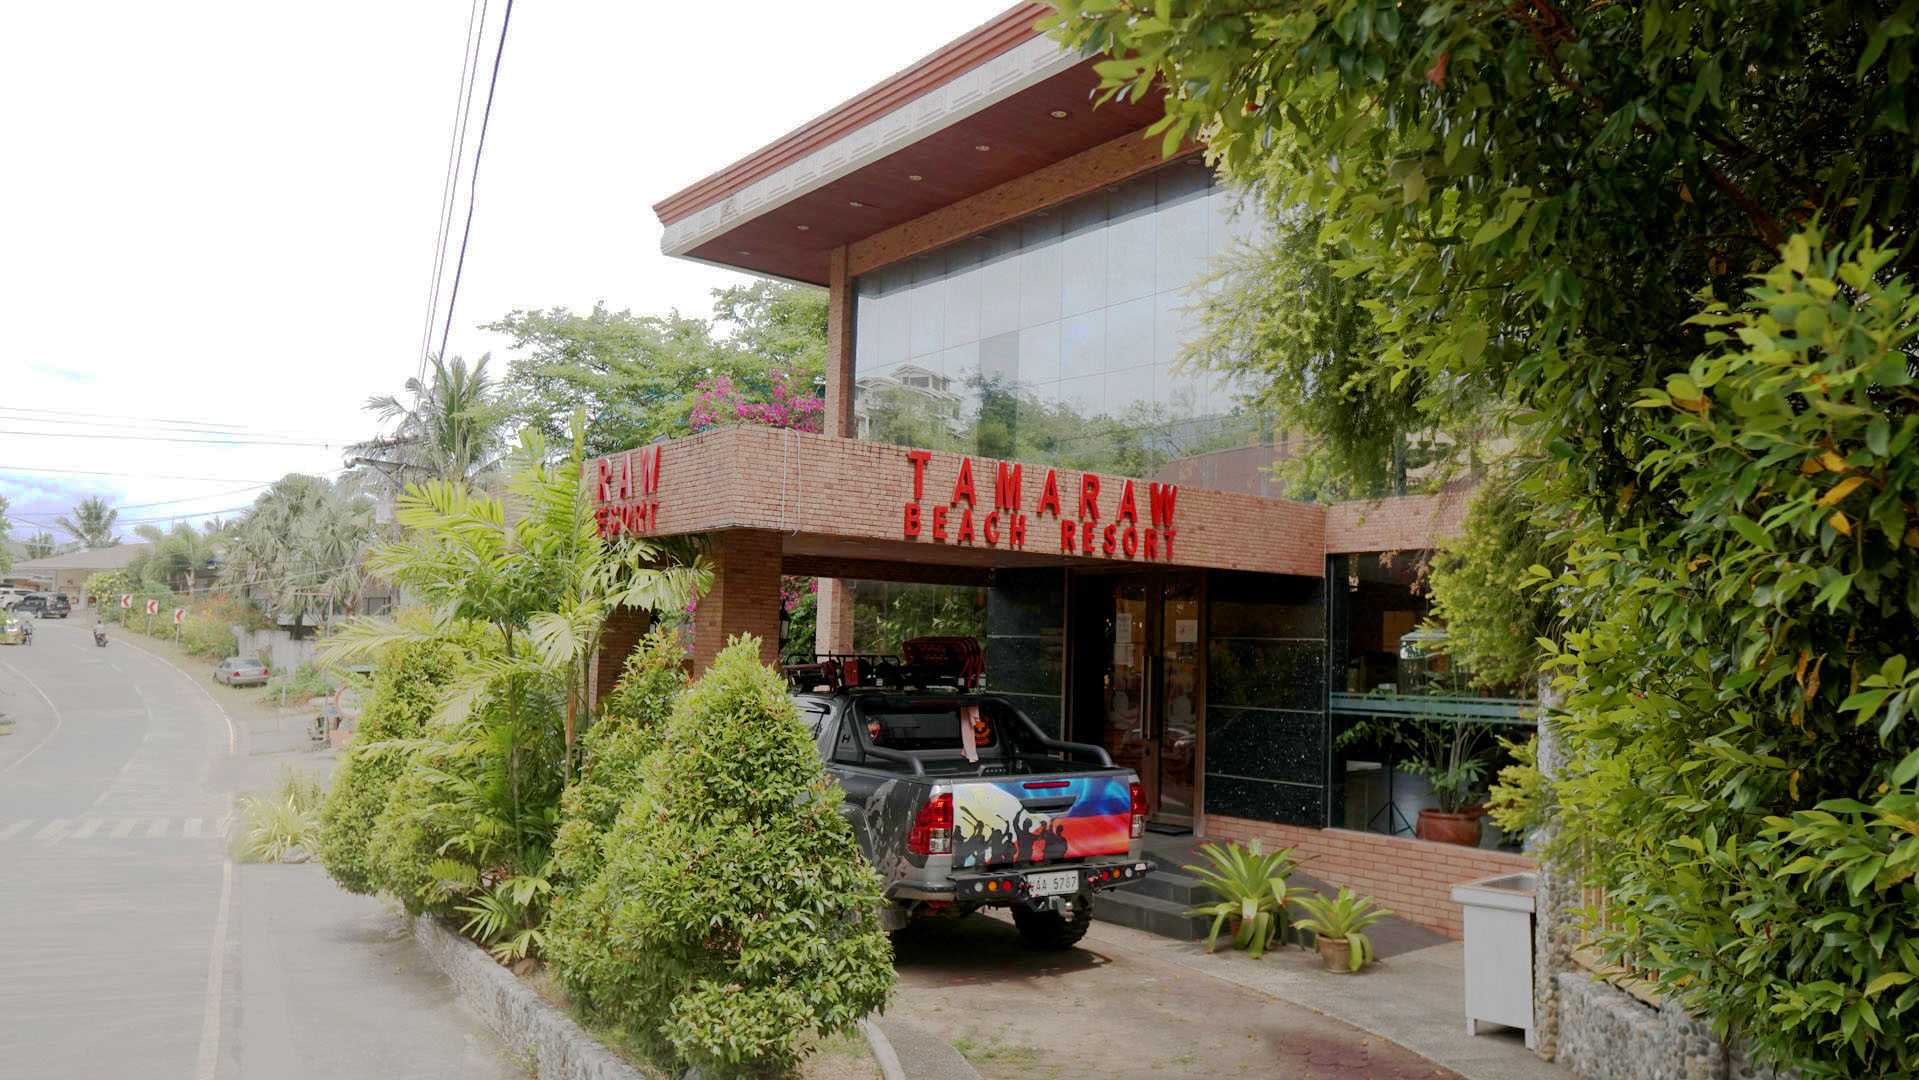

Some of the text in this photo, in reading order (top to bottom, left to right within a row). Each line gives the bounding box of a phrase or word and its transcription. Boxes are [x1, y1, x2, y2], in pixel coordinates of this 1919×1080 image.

[587, 445, 661, 502] RAW
[906, 450, 1177, 527] TAMARAW
[590, 499, 660, 537] ESORT
[904, 503, 1176, 560] BEACH RESORT
[1053, 876, 1077, 890] 5787
